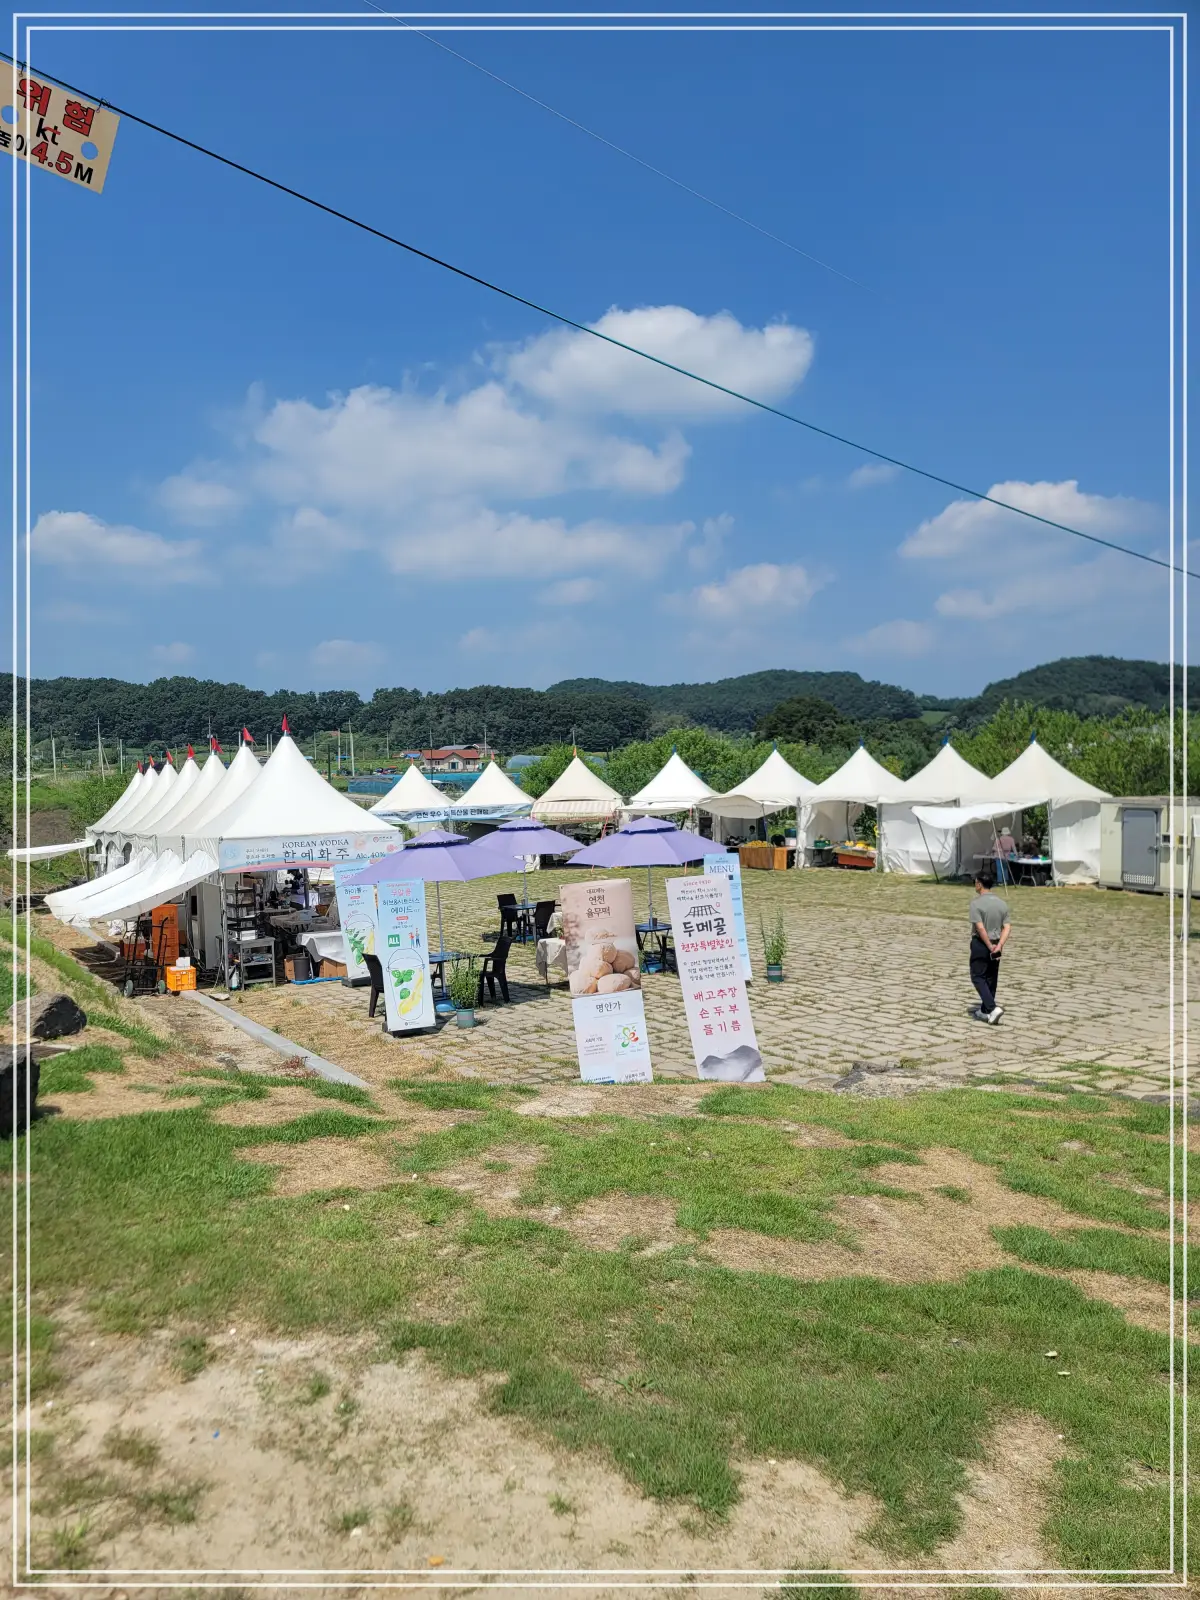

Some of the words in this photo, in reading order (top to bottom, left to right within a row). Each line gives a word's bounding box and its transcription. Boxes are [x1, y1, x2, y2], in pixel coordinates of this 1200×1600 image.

[16, 78, 96, 137] 위험
[36, 117, 61, 145] kt
[282, 840, 317, 849] KOREAN
[320, 838, 349, 847] VODKA
[709, 865, 735, 874] MENU
[588, 894, 606, 906] 연천
[390, 906, 413, 914] 에이드
[683, 917, 727, 937] 두메골
[681, 938, 734, 953] 현장특별할인
[596, 1001, 622, 1013] 명인가
[699, 1004, 740, 1019] 손두부
